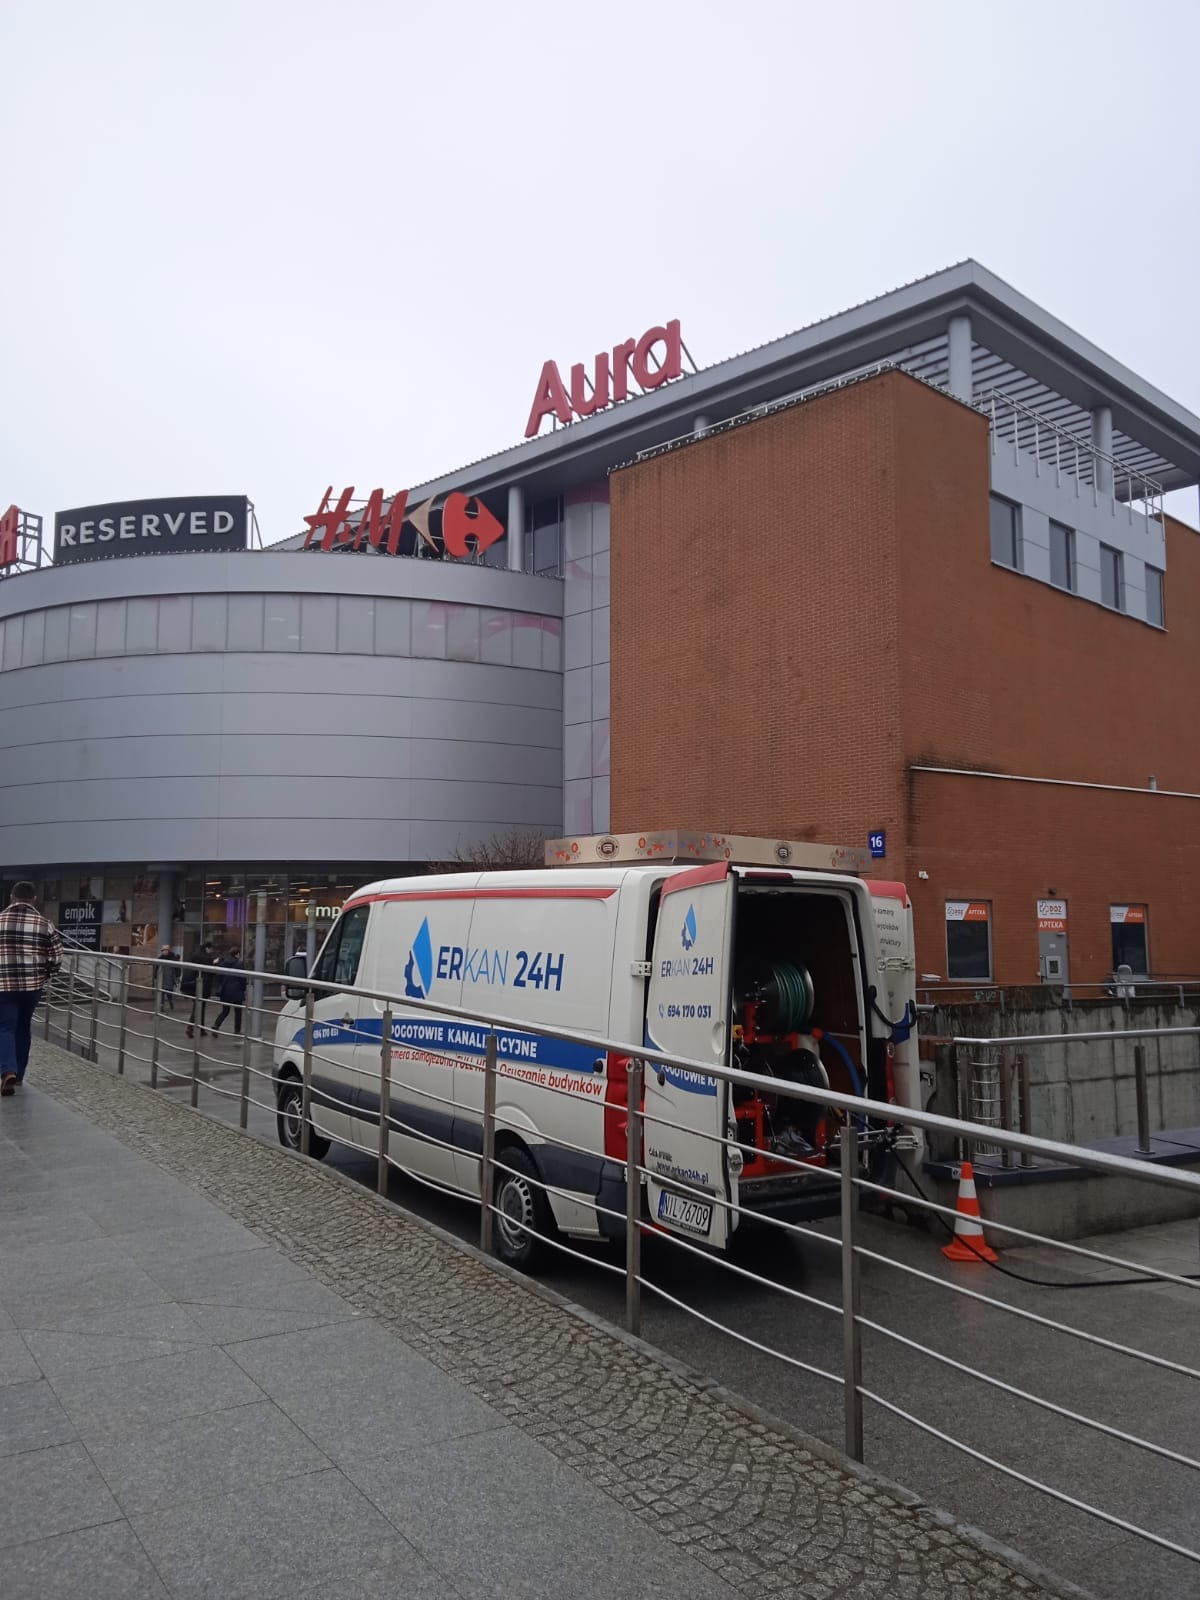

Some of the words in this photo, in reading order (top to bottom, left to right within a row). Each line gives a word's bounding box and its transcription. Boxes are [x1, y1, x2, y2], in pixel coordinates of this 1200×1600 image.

[524, 318, 681, 438] Aura
[60, 511, 234, 547] RESERVED
[303, 486, 409, 555] H&M
[870, 835, 883, 848] 16
[65, 901, 95, 921] empik
[1049, 905, 1063, 913] DOZ
[1039, 920, 1063, 929] APTEKA
[436, 946, 508, 986] ERKAN
[513, 950, 564, 991] 24H
[661, 959, 691, 977] ERKAN
[692, 957, 714, 976] 24H
[668, 1005, 680, 1018] 694
[682, 1005, 695, 1018] 170
[697, 1005, 712, 1018] 031
[448, 1026, 538, 1058] KANALICYJNE
[549, 1072, 603, 1096] budynków
[661, 1064, 706, 1085] OGOTOWIE
[664, 1193, 678, 1218] NIL
[680, 1200, 709, 1228] 76709
